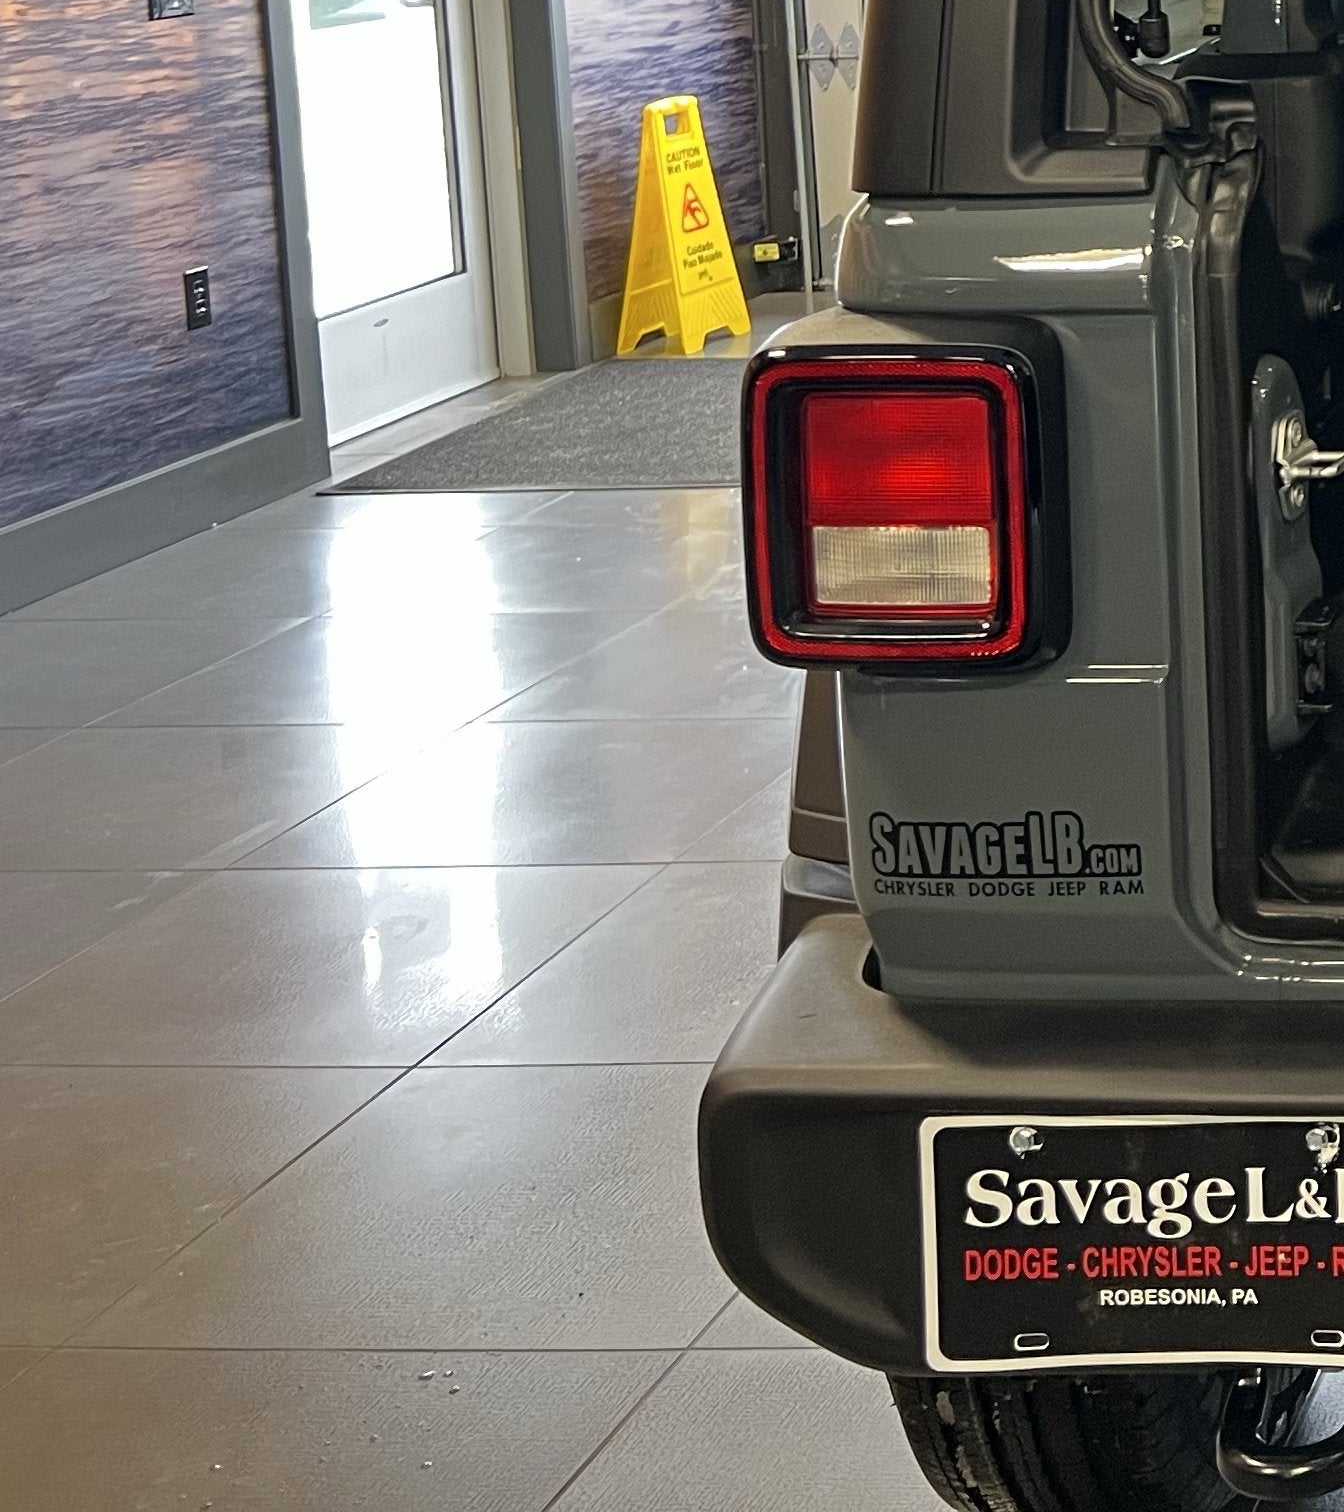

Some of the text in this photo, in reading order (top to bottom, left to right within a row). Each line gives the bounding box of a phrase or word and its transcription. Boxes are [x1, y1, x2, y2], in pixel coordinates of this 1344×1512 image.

[666, 147, 701, 163] CAUTION
[874, 879, 1145, 897] CHRYSLER DODGE JEEP RAM
[963, 1246, 1060, 1281] DODGE
[1081, 1245, 1223, 1279] CHRYSLER
[1244, 1244, 1310, 1278] JEEP
[1099, 1288, 1259, 1308] ROBESONIA, PA
